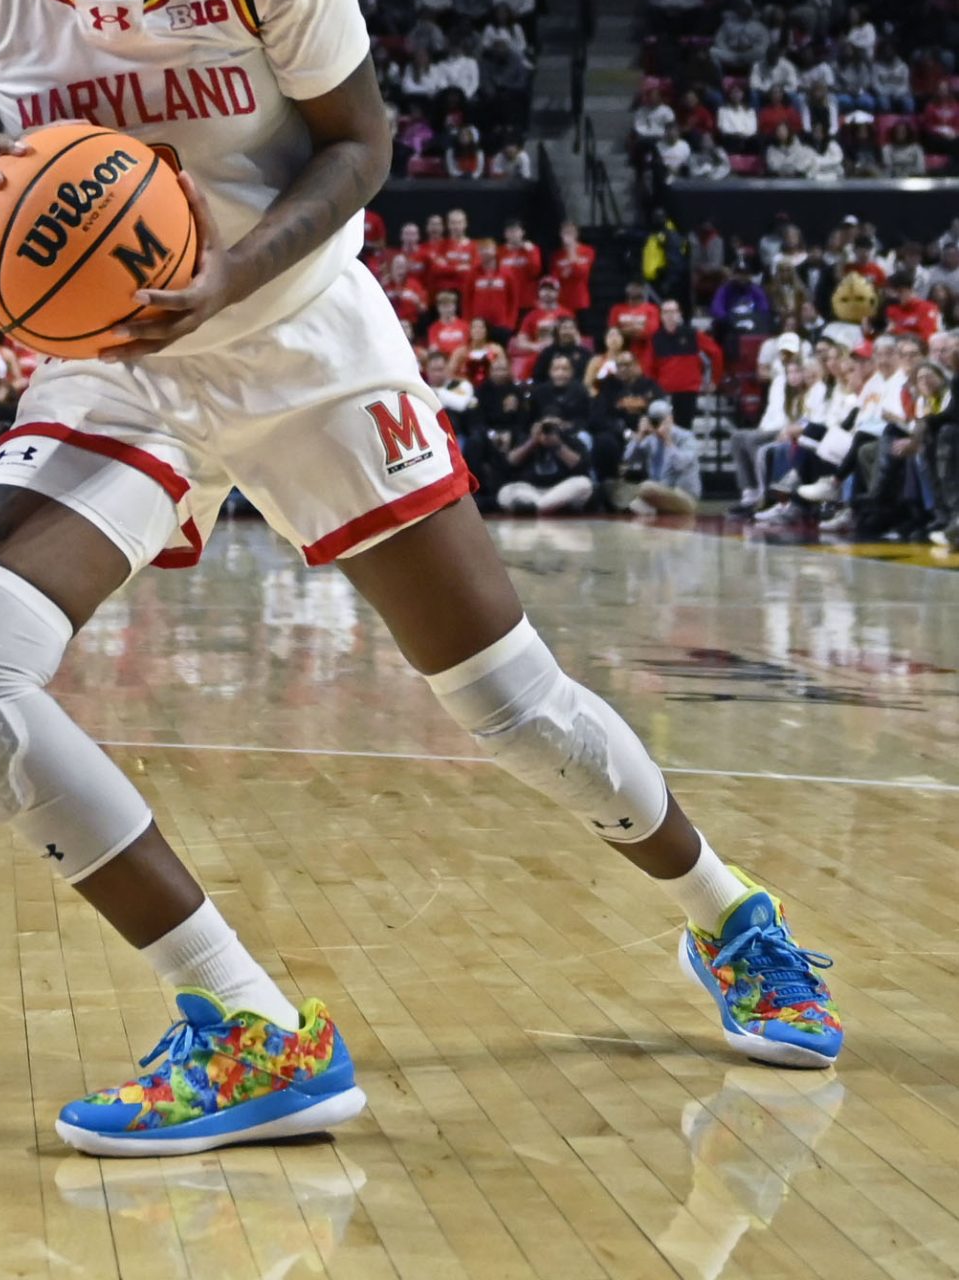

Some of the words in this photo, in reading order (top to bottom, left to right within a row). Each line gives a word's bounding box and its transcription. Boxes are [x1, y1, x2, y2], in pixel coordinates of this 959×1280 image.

[16, 65, 256, 130] MARYLAND
[16, 150, 138, 267] Wilson
[110, 218, 171, 288] M
[364, 390, 430, 465] M
